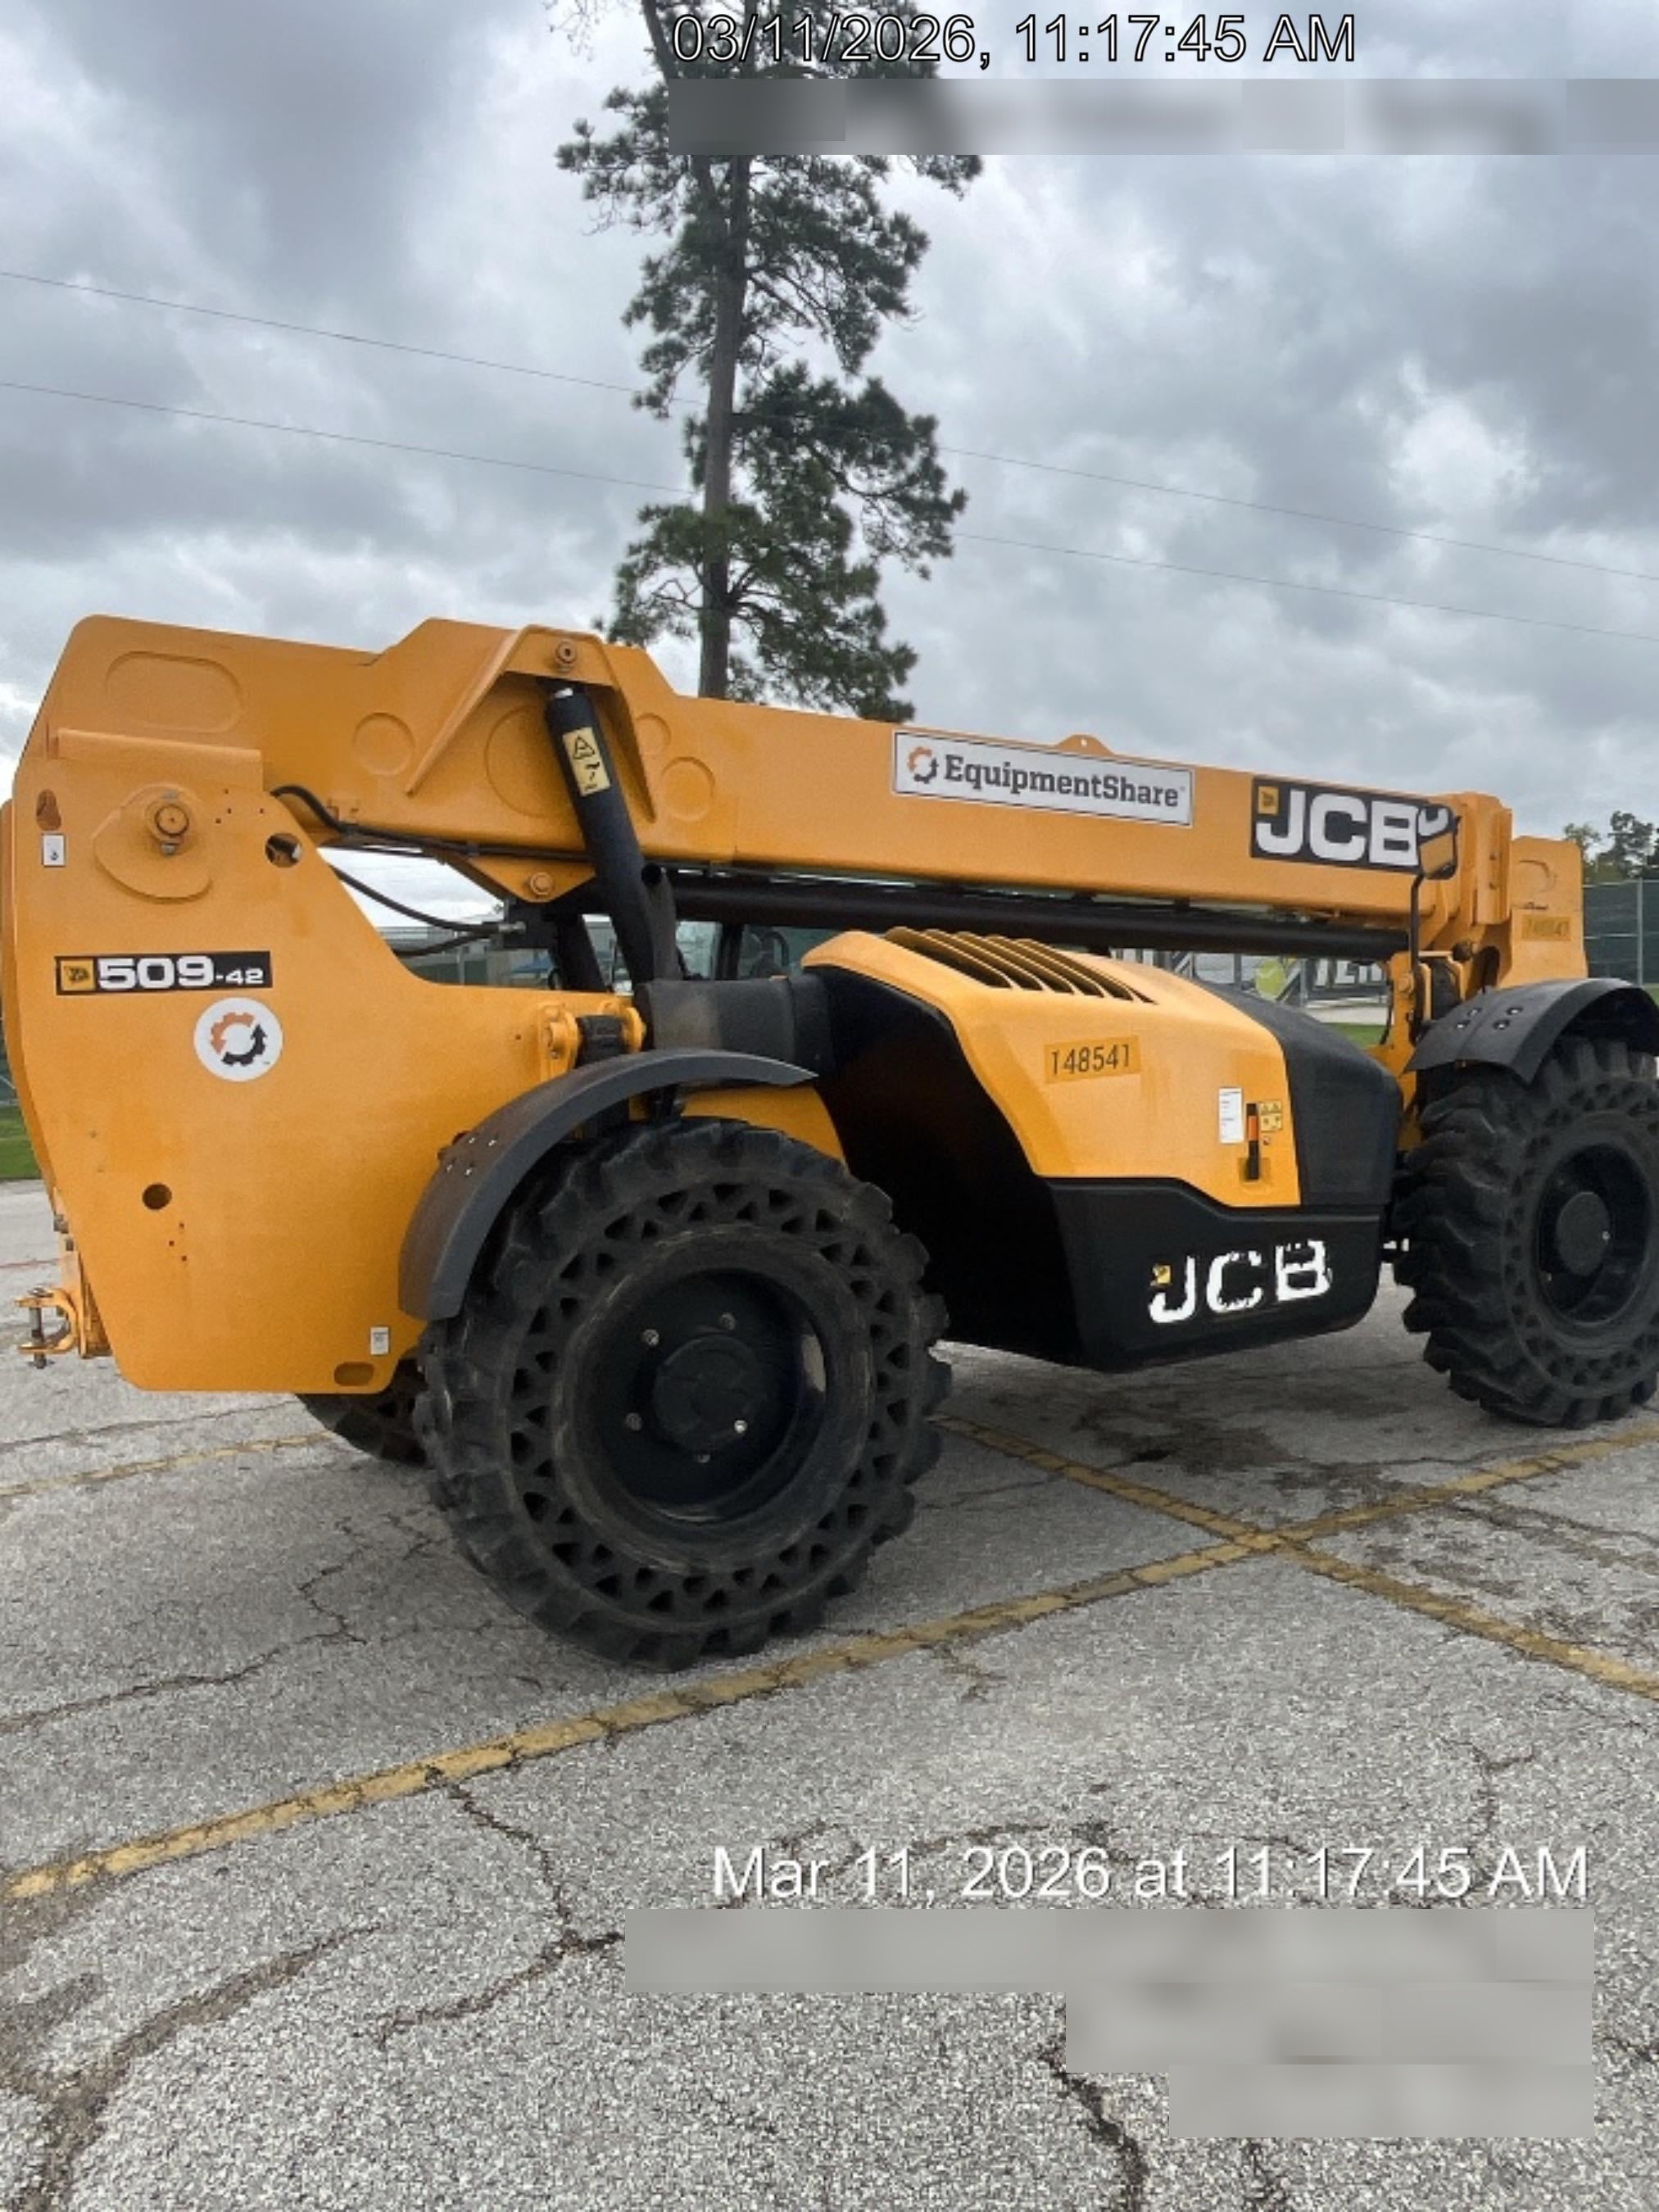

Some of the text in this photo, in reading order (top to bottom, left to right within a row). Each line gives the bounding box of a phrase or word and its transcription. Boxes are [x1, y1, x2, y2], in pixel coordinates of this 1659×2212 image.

[944, 753, 1179, 808] EquipmentShare
[1255, 788, 1420, 867] JCB
[97, 954, 264, 990] 509-42
[1050, 1043, 1130, 1076] 148541
[1149, 1239, 1334, 1324] JCB
